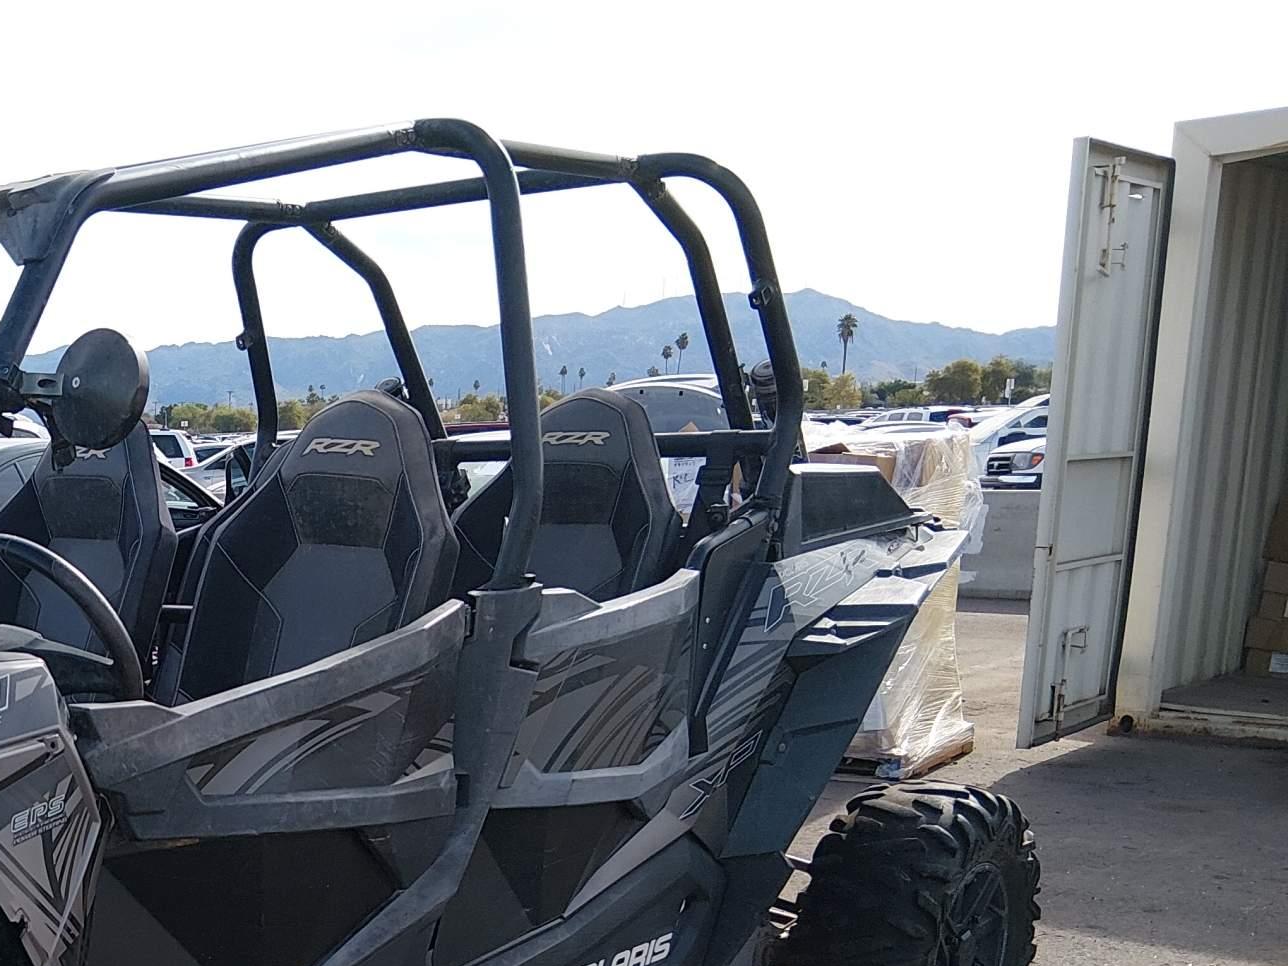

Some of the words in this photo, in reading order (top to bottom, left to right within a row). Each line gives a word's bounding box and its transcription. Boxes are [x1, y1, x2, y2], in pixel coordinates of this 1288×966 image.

[302, 437, 380, 456] RZR
[542, 432, 610, 446] RZR
[764, 543, 880, 633] RZR
[679, 730, 763, 820] XP
[11, 794, 65, 833] EPS
